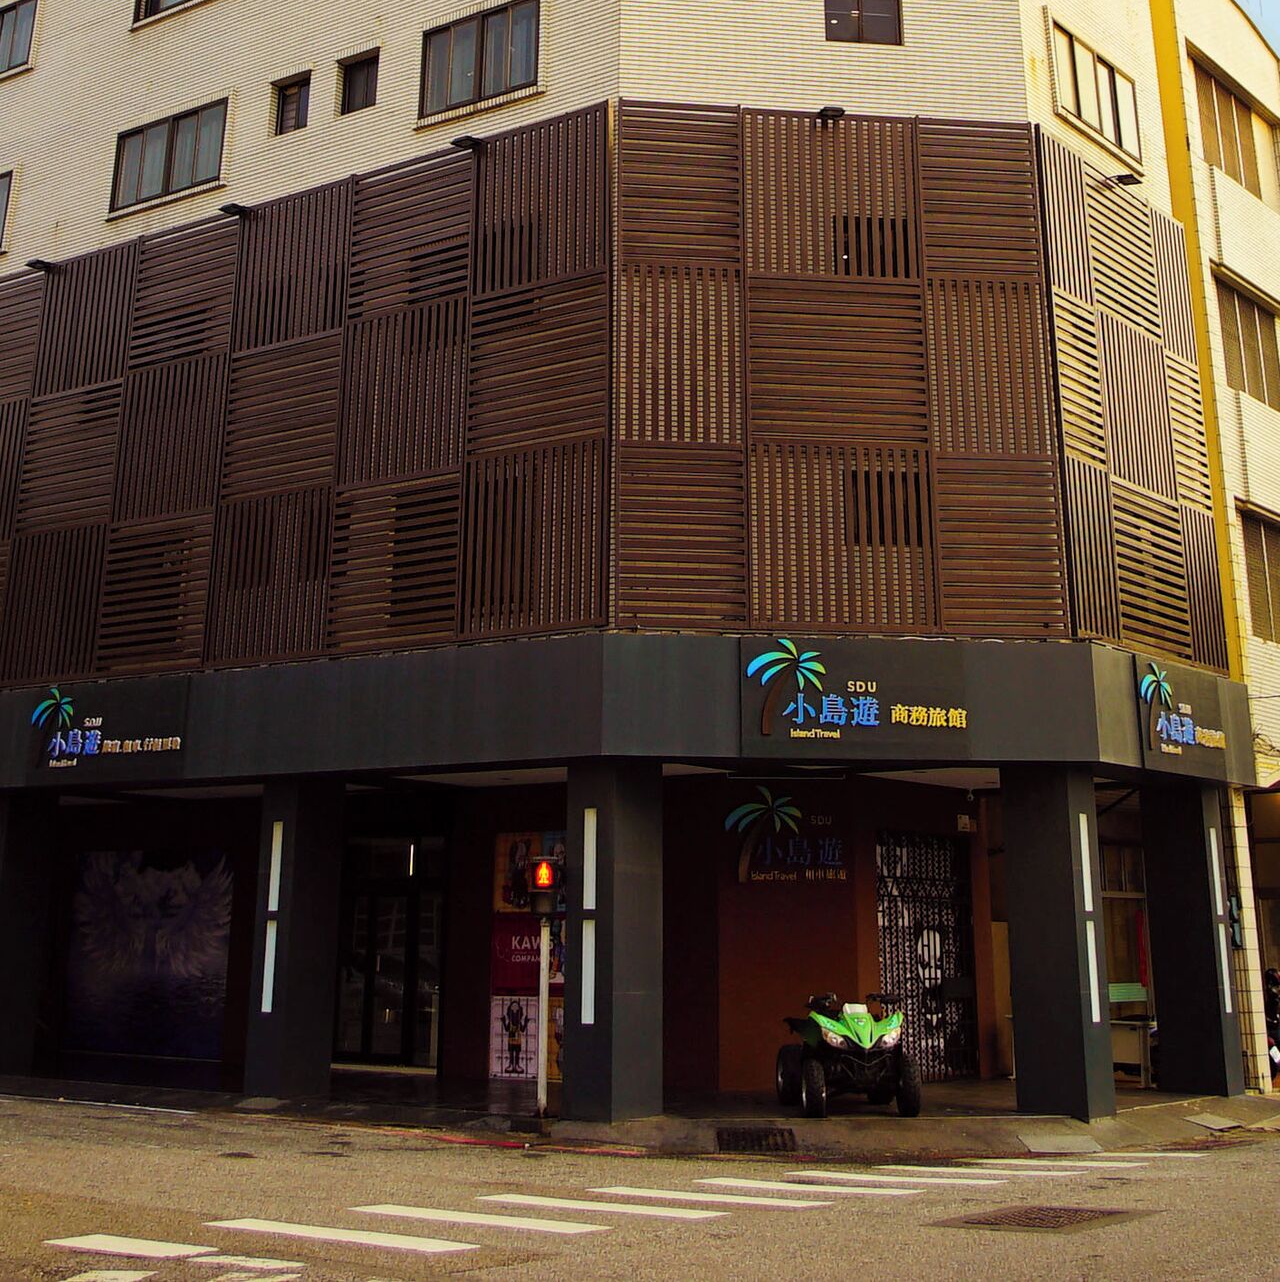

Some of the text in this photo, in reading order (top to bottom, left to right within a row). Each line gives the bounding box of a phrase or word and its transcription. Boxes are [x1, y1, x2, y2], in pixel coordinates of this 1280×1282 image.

[847, 680, 877, 693] SDU
[782, 692, 968, 729] 小島遊 商務旅館
